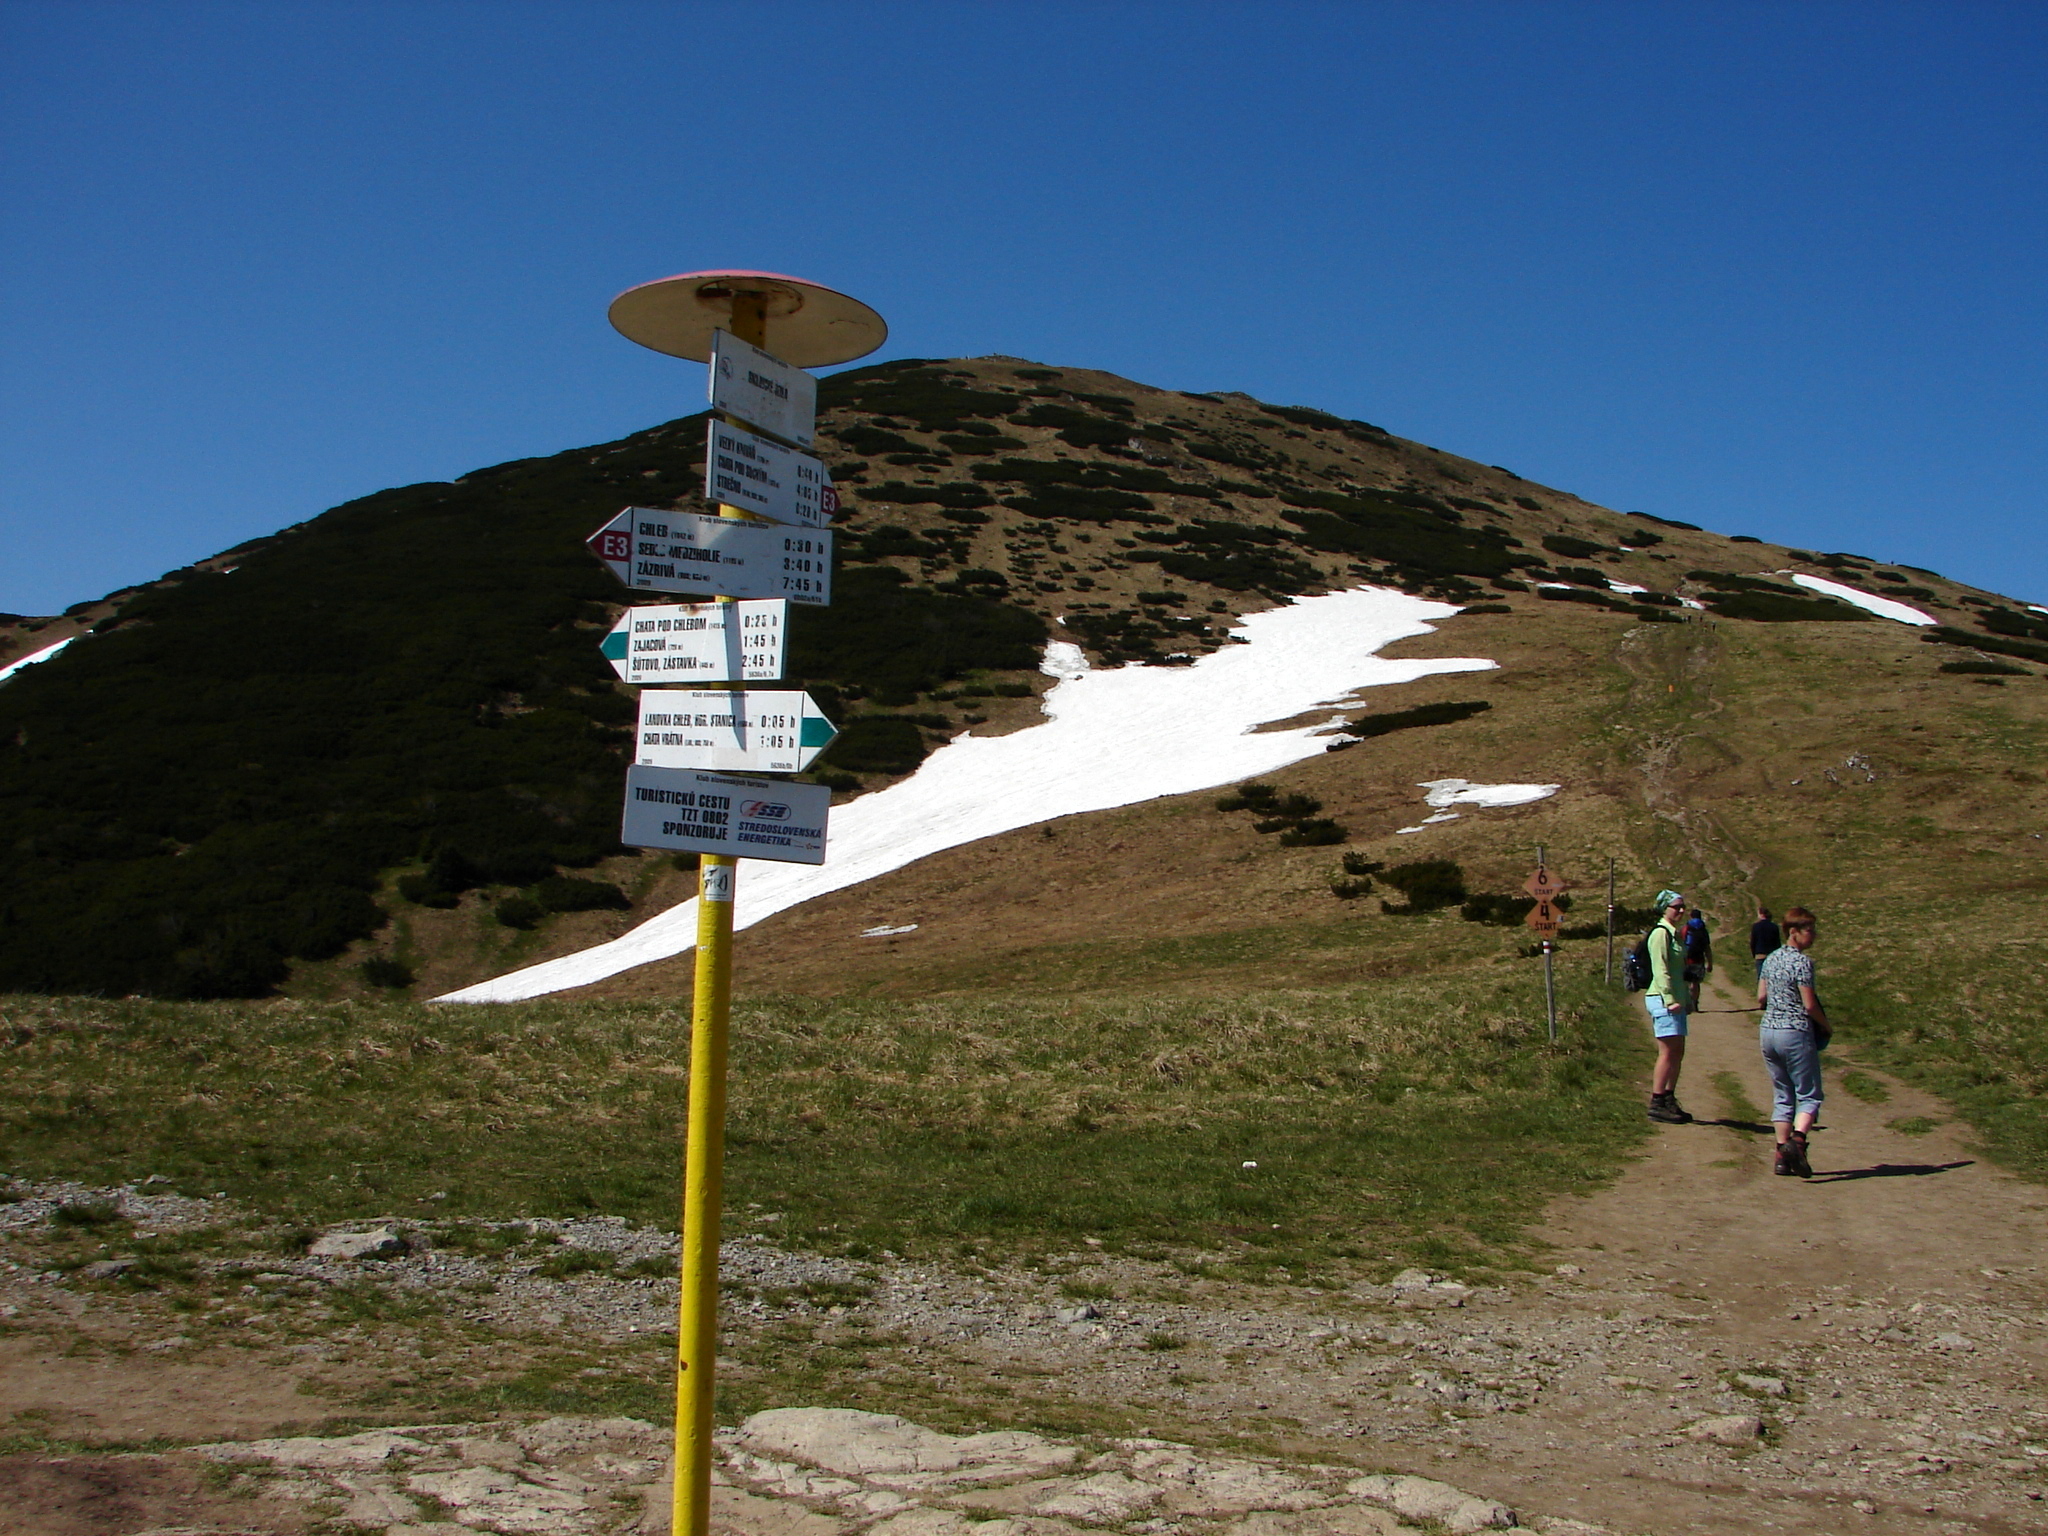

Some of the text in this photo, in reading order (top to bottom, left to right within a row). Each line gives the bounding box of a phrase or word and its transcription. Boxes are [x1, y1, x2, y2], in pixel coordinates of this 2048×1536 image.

[823, 490, 835, 512] E3
[640, 522, 668, 538] CHLEB
[604, 535, 628, 557] E3
[784, 538, 824, 554] 0:30 h
[638, 560, 675, 578] ZÁZRIVÁ
[784, 558, 822, 574] 3:40 h
[783, 577, 822, 592] 7:45 h
[635, 620, 655, 633] CHATA
[658, 618, 671, 632] POD
[674, 618, 707, 631] CHLEBOM
[745, 614, 777, 628] 0:25 h
[633, 637, 666, 652] ZAJACOVÁ
[744, 634, 776, 647] 1:45 h
[632, 657, 661, 672] ŠÚTOVO,
[663, 656, 697, 670] ZÁSTAVKA
[742, 654, 774, 668] 2:45 h
[645, 714, 671, 727] LANOVKA
[711, 715, 736, 727] STANICA
[761, 715, 785, 729] 0:05
[790, 716, 795, 728] h
[644, 733, 660, 745] CHATA
[662, 731, 683, 745] VRÁTNA
[789, 736, 794, 748] h
[696, 774, 769, 789] Klub slovenských turistov
[636, 787, 730, 810] TURISTICKÚ CESTU
[682, 807, 729, 826] TZT 0802
[662, 822, 728, 841] SPONZORUJE
[738, 822, 822, 838] STREDOSLOVENSKÁ
[738, 832, 791, 847] ENERGETIKA
[1538, 869, 1548, 885] 6
[1540, 904, 1549, 920] 4
